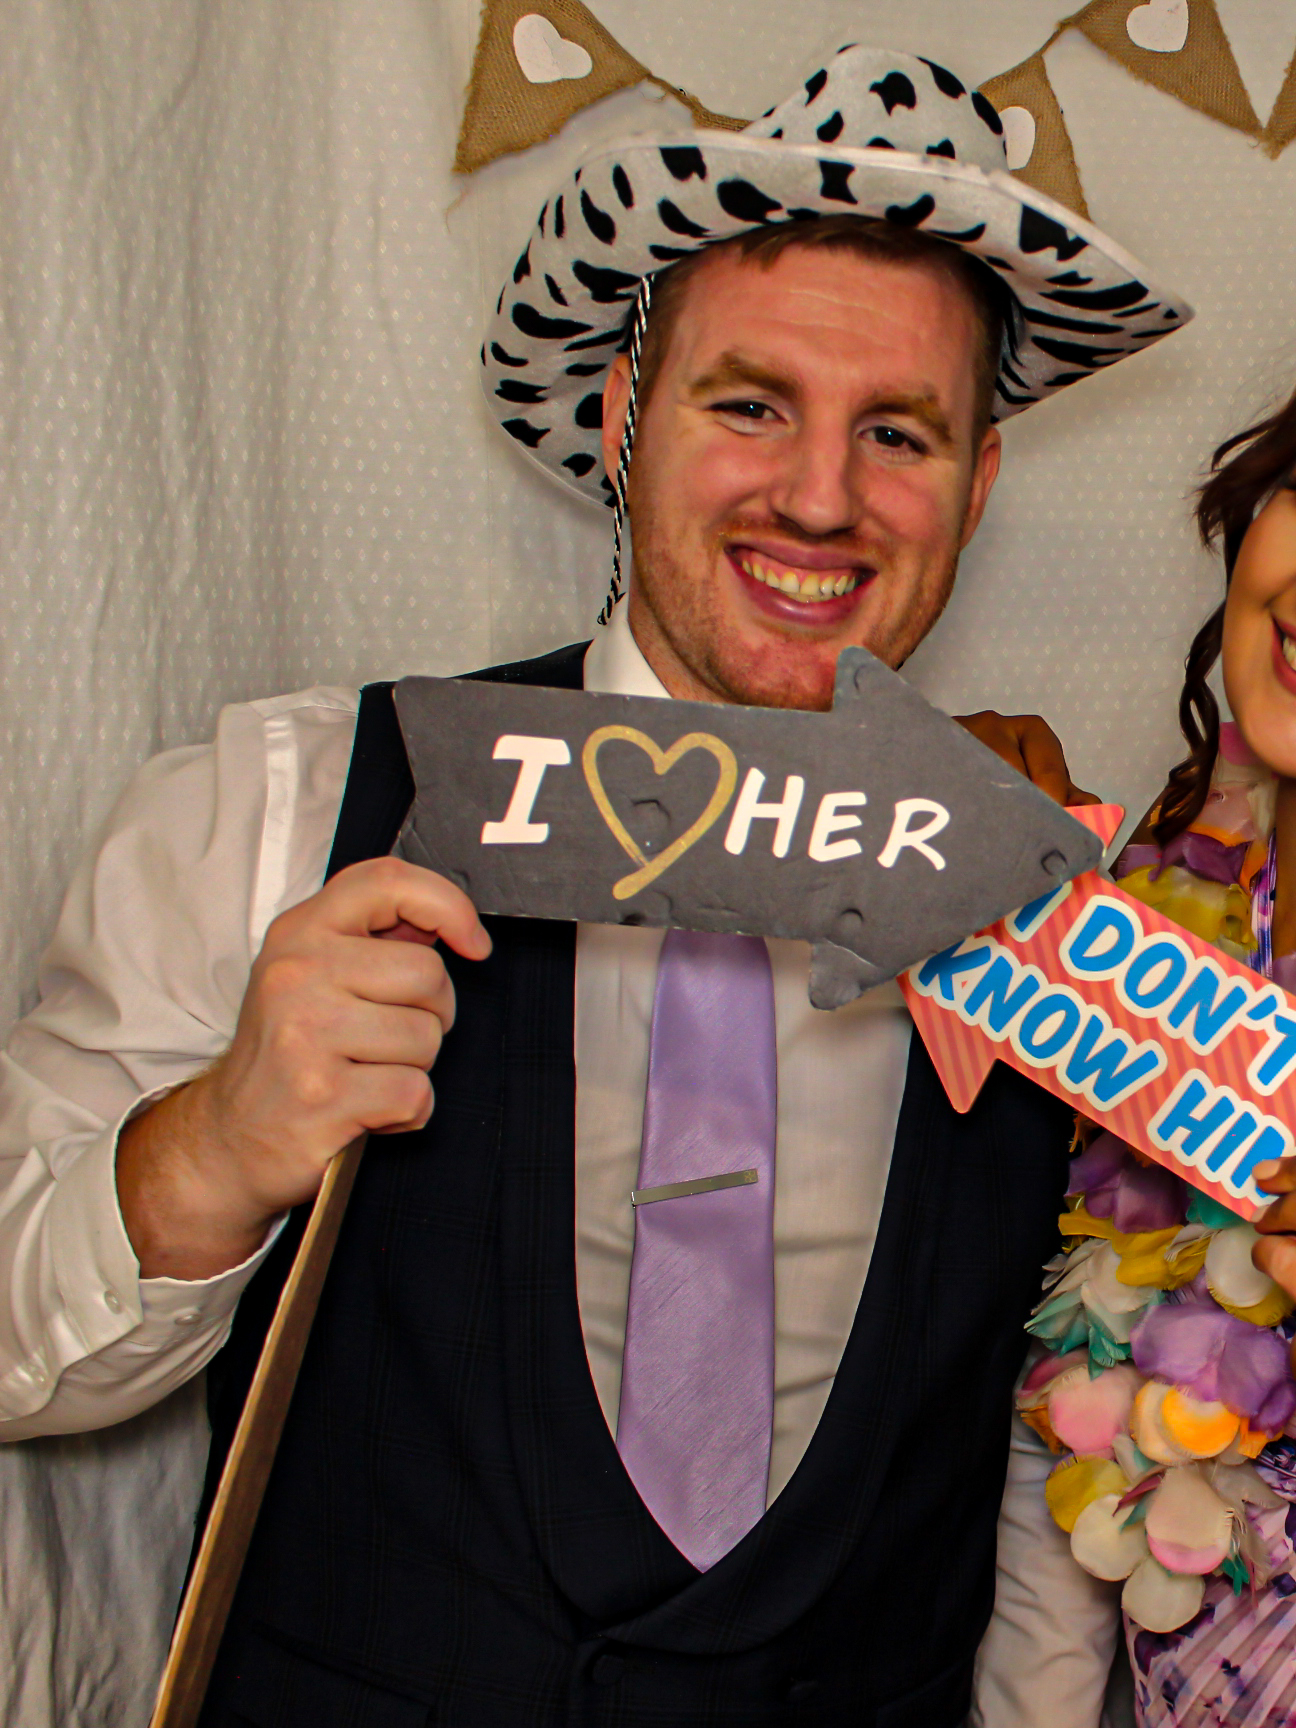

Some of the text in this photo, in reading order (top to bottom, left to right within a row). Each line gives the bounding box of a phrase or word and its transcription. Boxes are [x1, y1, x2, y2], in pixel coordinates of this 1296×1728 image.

[481, 734, 951, 872] I HER
[918, 938, 1160, 1104] KNOW
